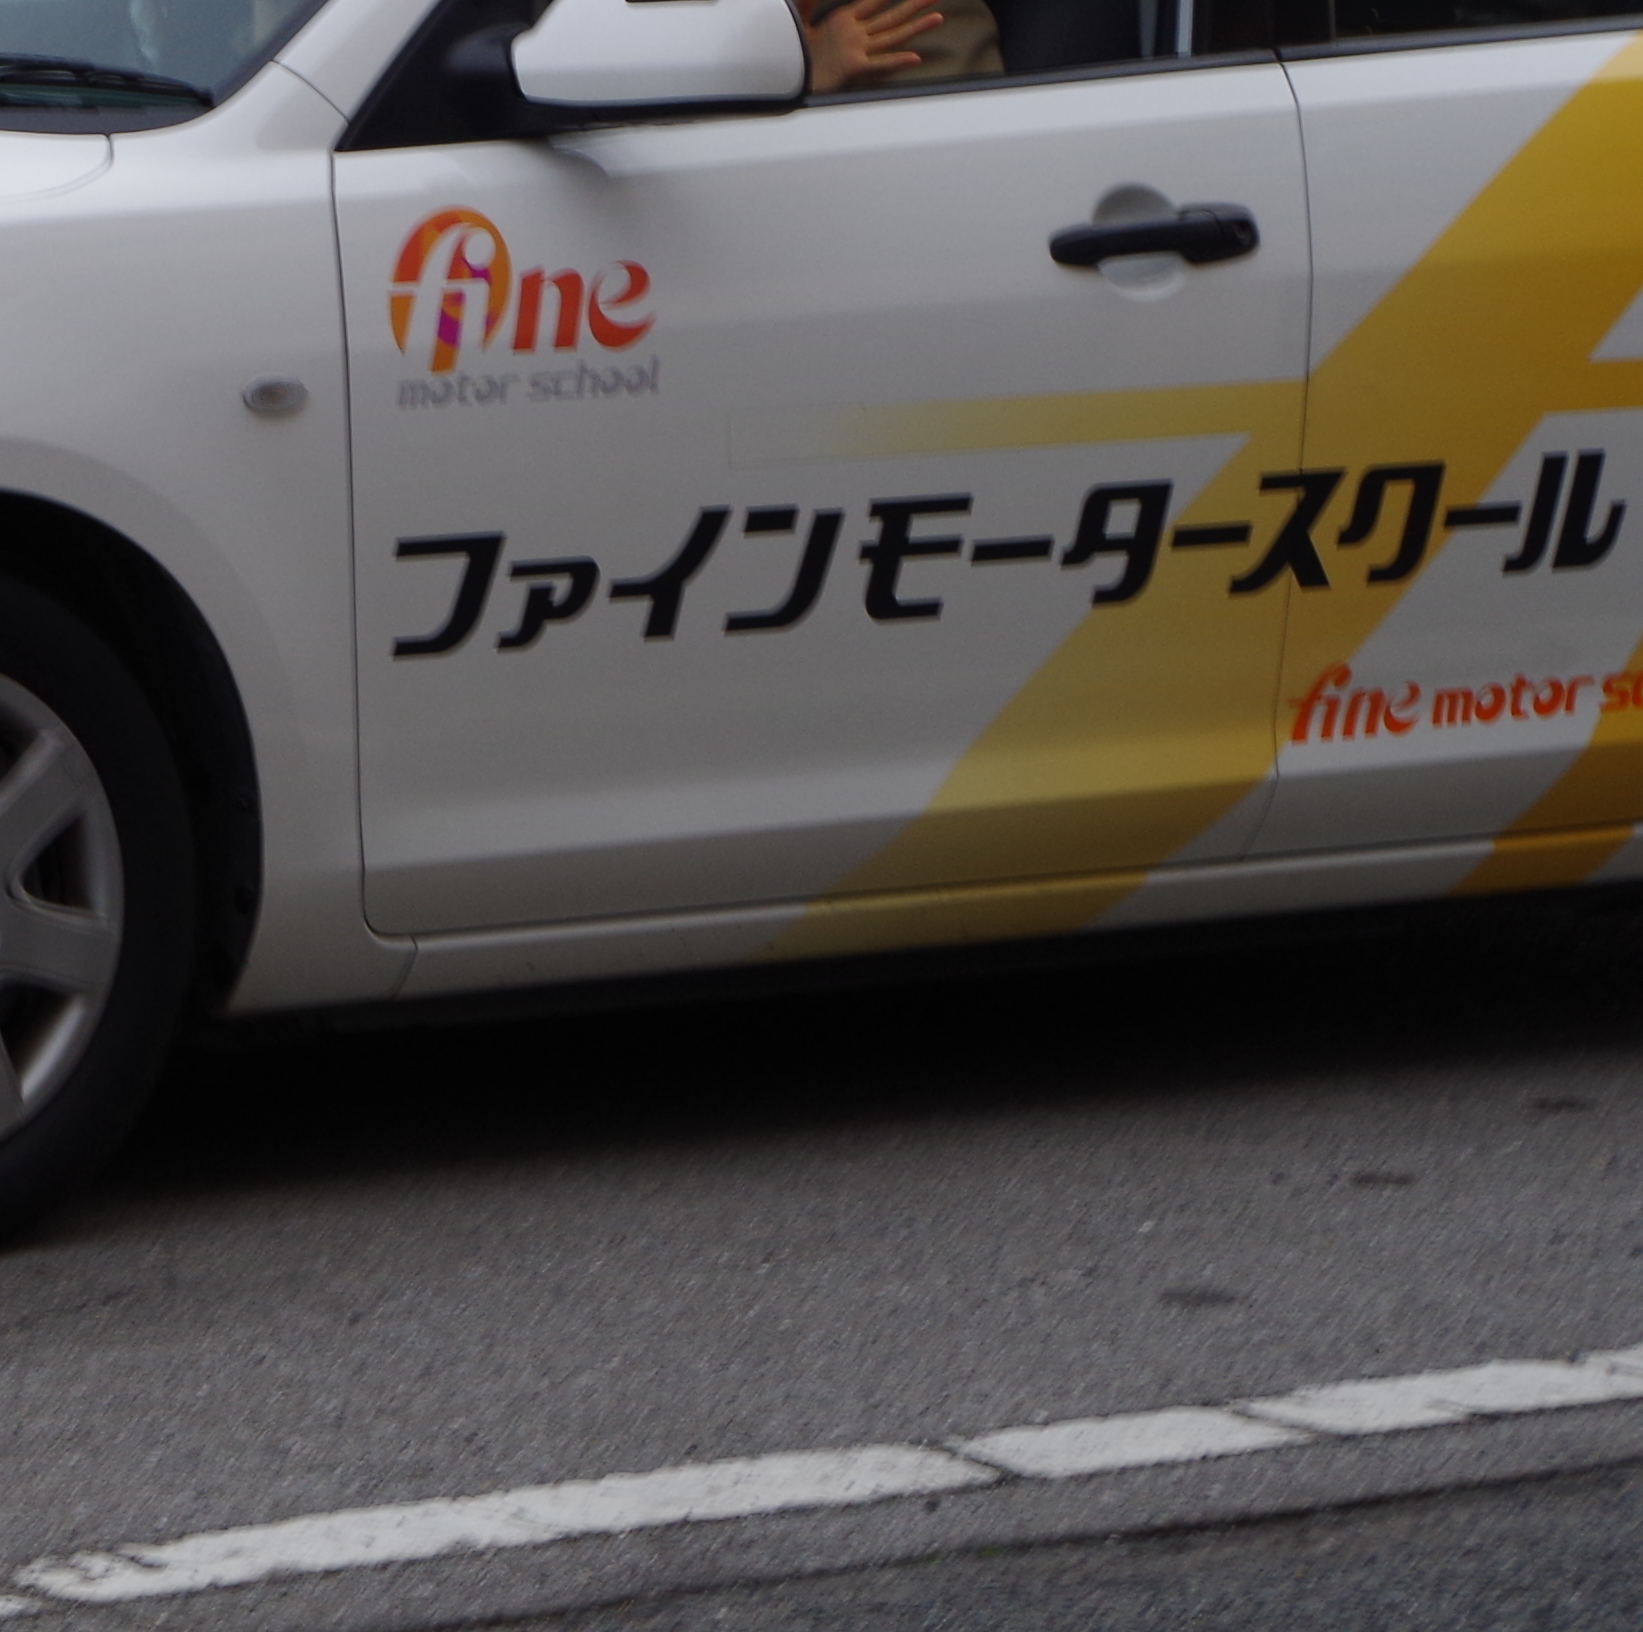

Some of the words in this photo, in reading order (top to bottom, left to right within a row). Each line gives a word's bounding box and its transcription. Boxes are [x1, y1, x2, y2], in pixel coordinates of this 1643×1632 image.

[389, 206, 658, 374] fine
[398, 371, 517, 408] motor
[528, 354, 660, 401] school
[391, 448, 1627, 658] ファインモータースクール
[1289, 663, 1422, 745] fine
[1431, 672, 1595, 729] motor
